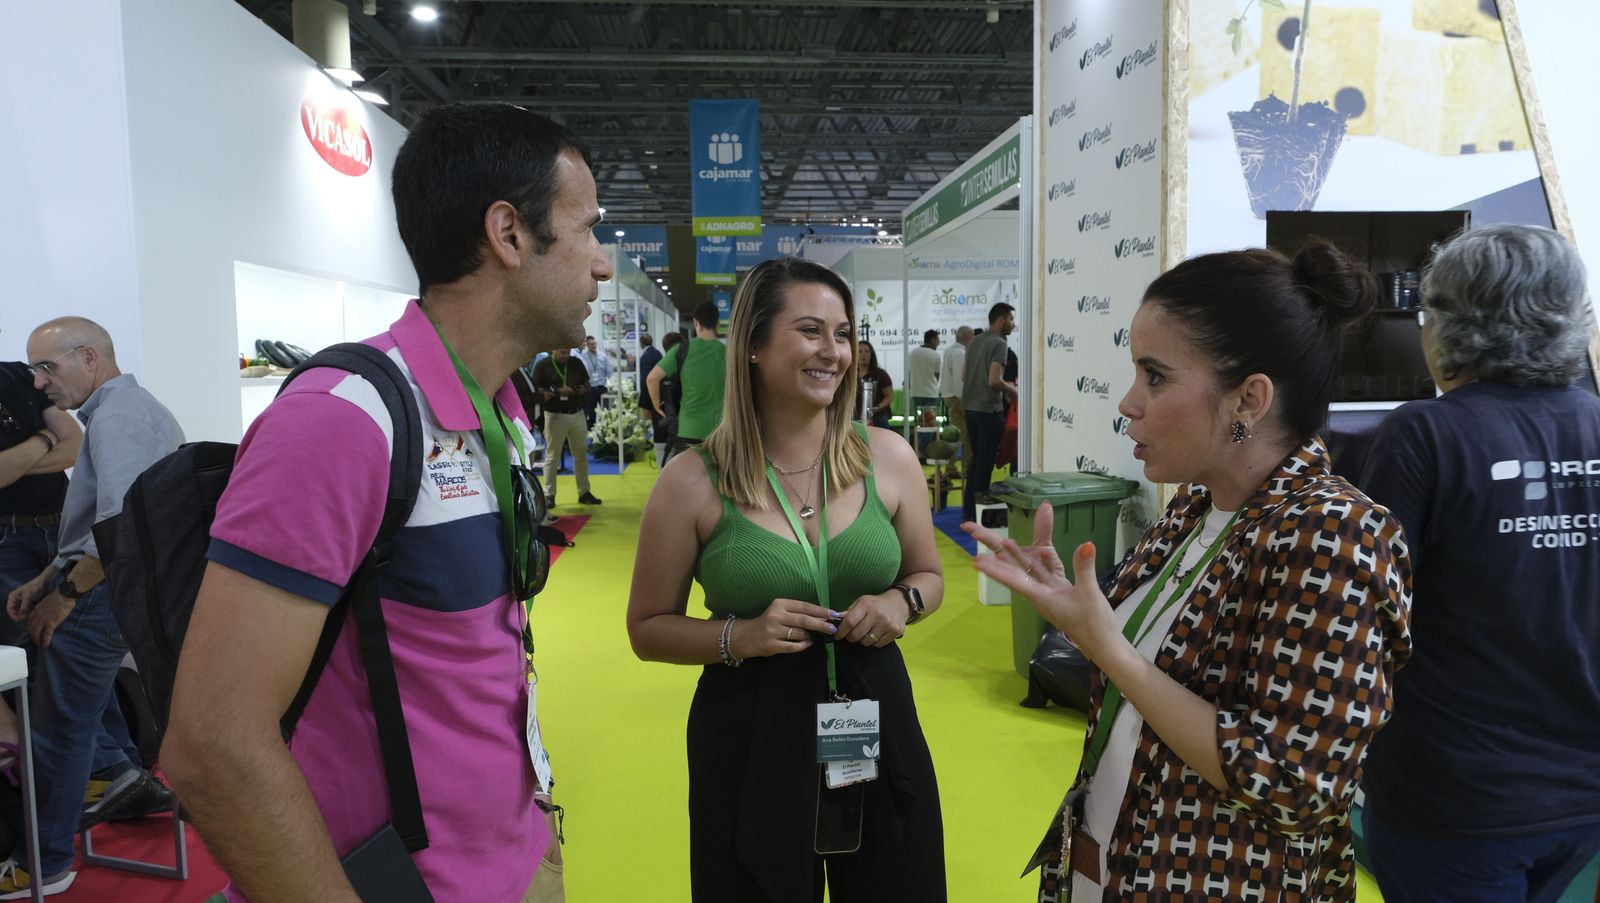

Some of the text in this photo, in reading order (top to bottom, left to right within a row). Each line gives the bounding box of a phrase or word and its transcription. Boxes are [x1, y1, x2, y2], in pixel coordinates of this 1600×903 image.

[1133, 40, 1157, 69] Plantel
[304, 105, 370, 168] VICASOL
[1132, 138, 1157, 163] Plantel
[699, 167, 752, 182] cajamar
[1132, 235, 1156, 255] Plantel
[944, 259, 994, 271] AgroDigital
[435, 477, 466, 486] MARCOS
[834, 718, 877, 729] El Plantel
